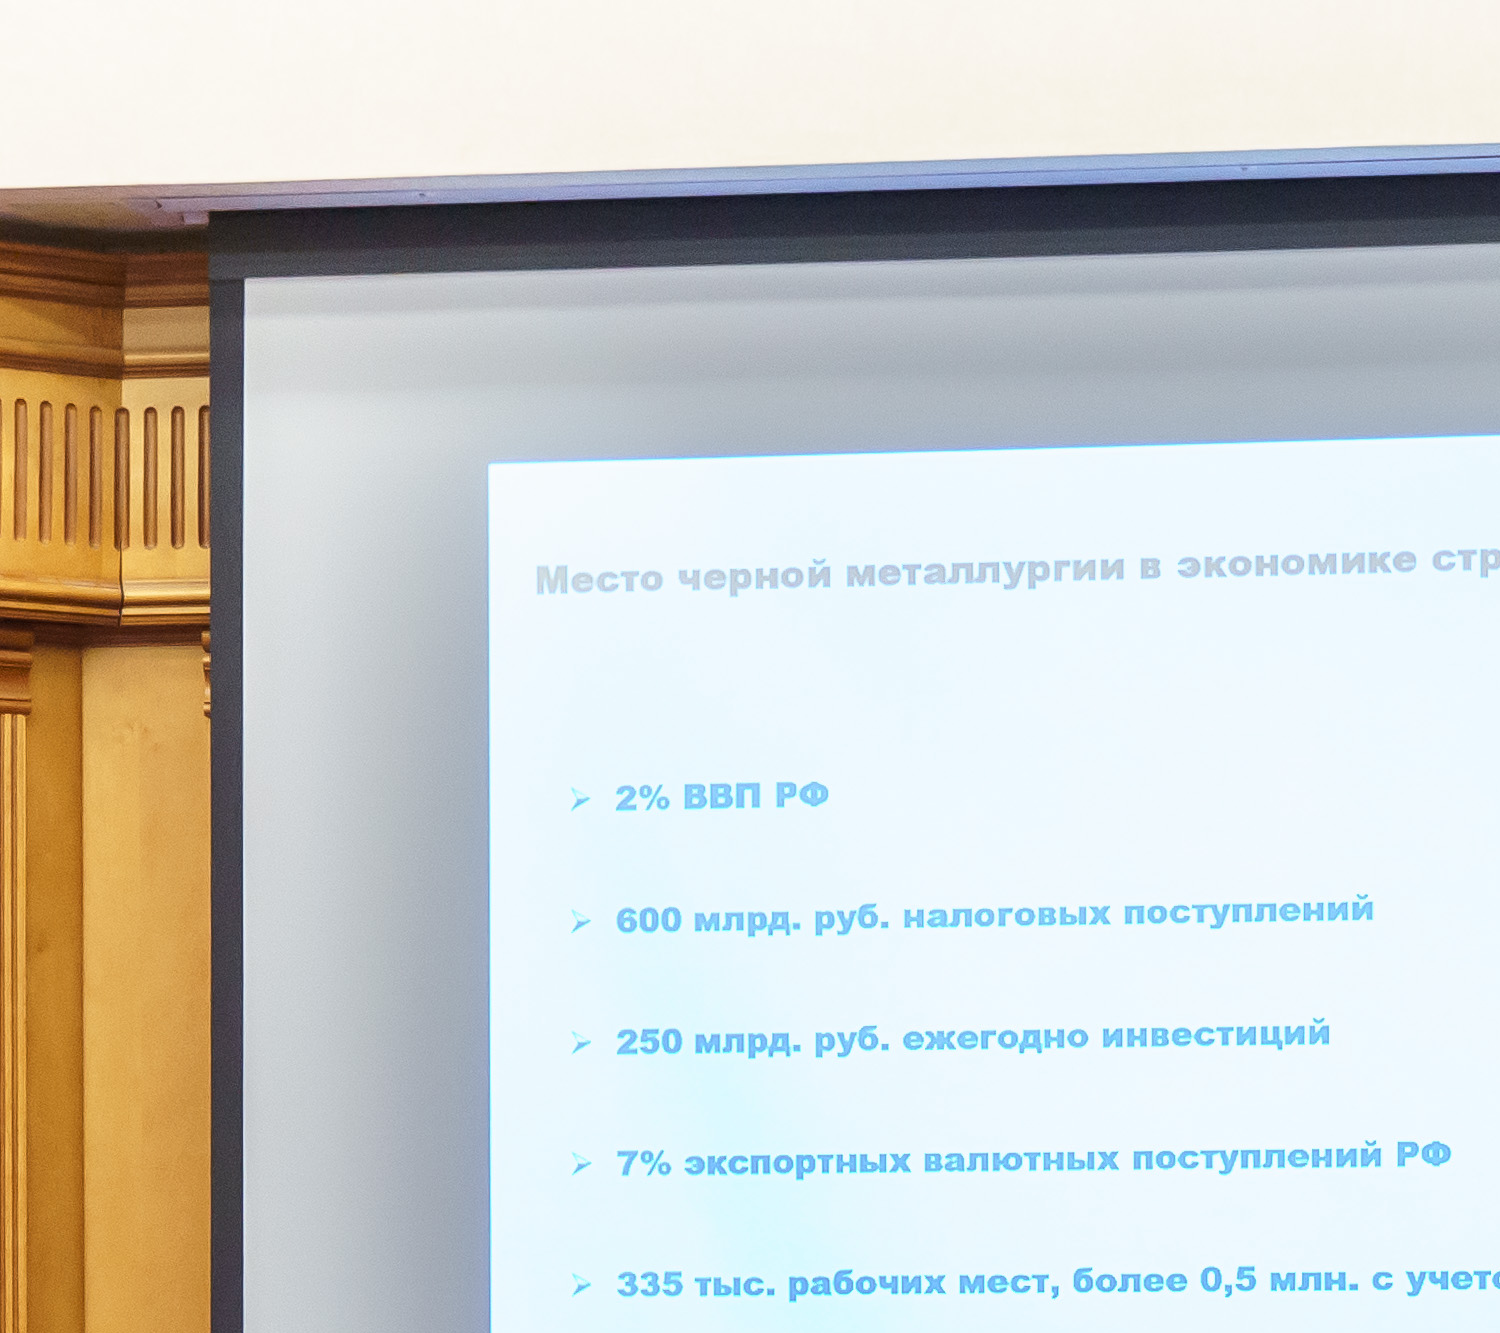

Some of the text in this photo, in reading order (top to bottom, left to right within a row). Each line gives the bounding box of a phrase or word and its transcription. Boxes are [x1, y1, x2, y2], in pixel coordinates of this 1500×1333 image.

[537, 565, 663, 595] Место
[678, 558, 831, 598] черной
[846, 558, 1124, 590] металлургии
[1140, 558, 1161, 580] в
[1177, 551, 1417, 578] экономике
[615, 781, 829, 812] 2% ВВП РФ
[616, 893, 1374, 938] 600 млрд. руб. налоговых поступлений
[616, 1017, 1330, 1060] 250 млрд. руб. ежегодно инвестиций
[616, 1140, 1452, 1181] 7% экспортных валютных поступлений РФ
[617, 1270, 684, 1298] 335
[694, 1276, 776, 1298] тыс.
[788, 1268, 947, 1304] рабочих
[958, 1273, 1060, 1300] мест,
[1072, 1266, 1189, 1294] более
[1200, 1265, 1257, 1299] 0,5
[1269, 1271, 1359, 1292] млн.
[1371, 1271, 1394, 1291] с
